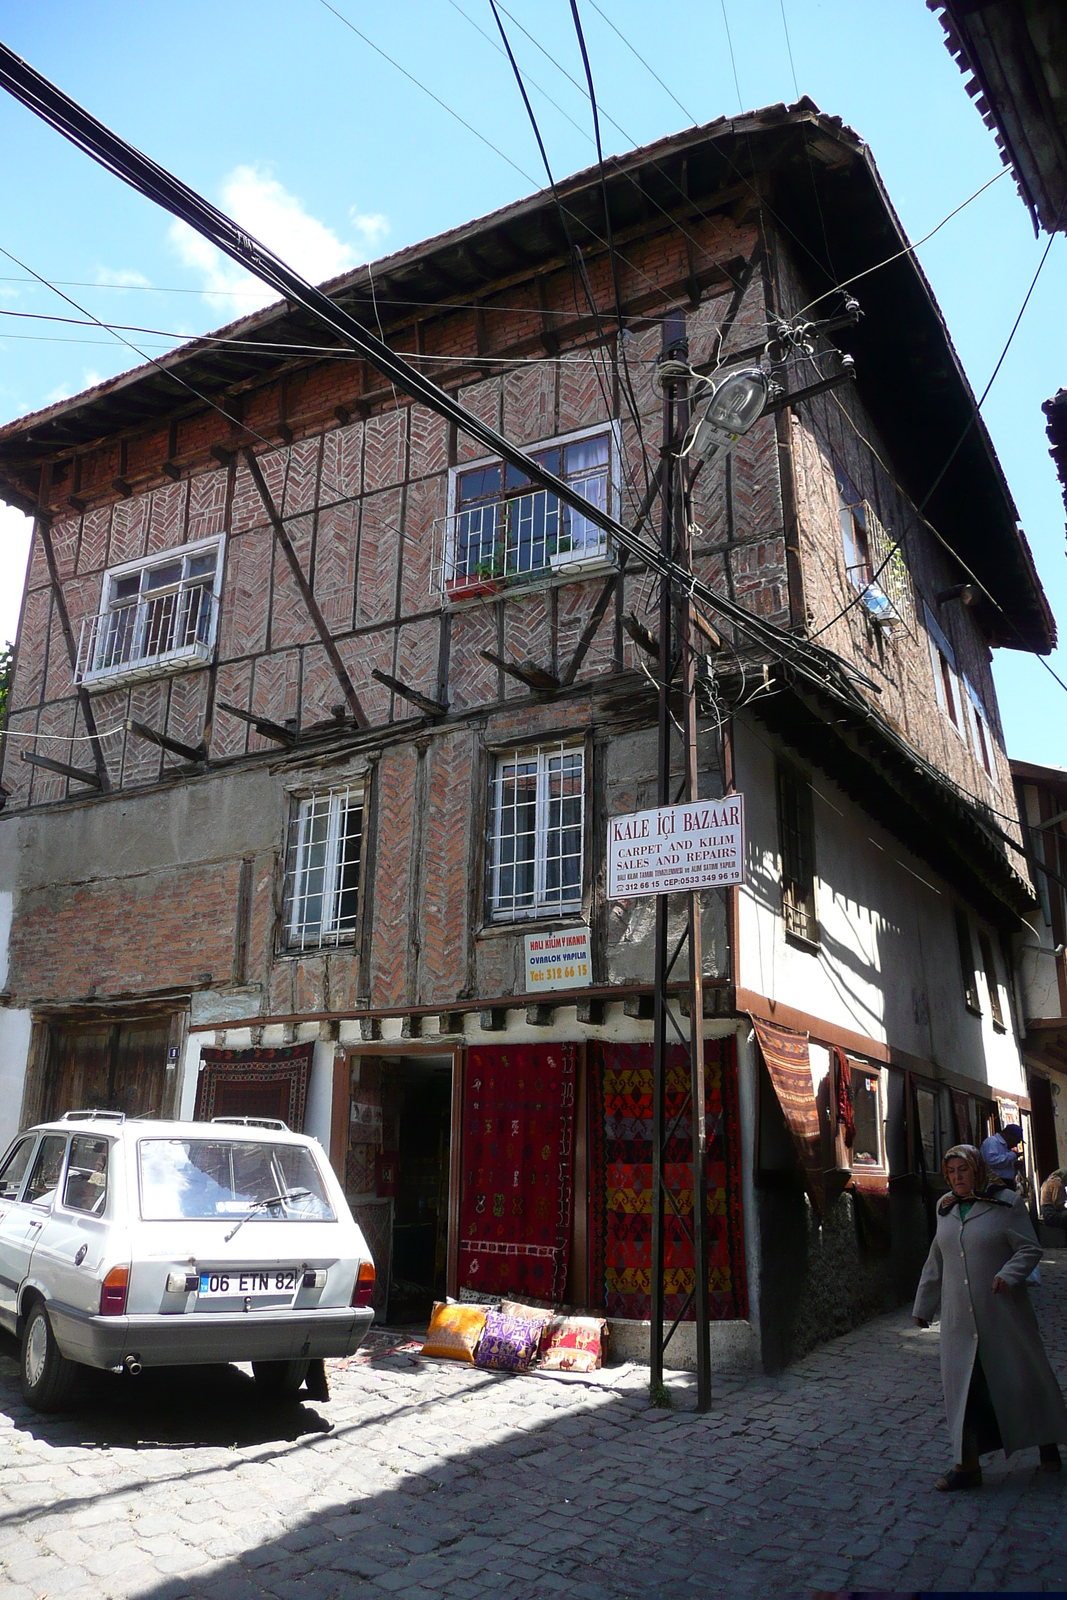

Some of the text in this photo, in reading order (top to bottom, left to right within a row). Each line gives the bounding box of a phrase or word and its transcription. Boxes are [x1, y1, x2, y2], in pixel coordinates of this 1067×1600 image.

[614, 806, 740, 841] KALE İÇİ BAZAAR
[618, 834, 734, 858] CARPET AND KILIM
[616, 847, 737, 871] SALES AND REPAIRS
[651, 880, 660, 888] 15
[701, 873, 716, 882] 349
[718, 872, 728, 880] 96
[730, 871, 739, 879] 19
[530, 940, 543, 951] HALI
[530, 951, 586, 965] OVARLOK YAPILIR
[530, 964, 587, 982] Tel: 312 66 15
[209, 1274, 229, 1292] 06
[239, 1273, 269, 1291] ETN
[275, 1272, 294, 1290] 82
